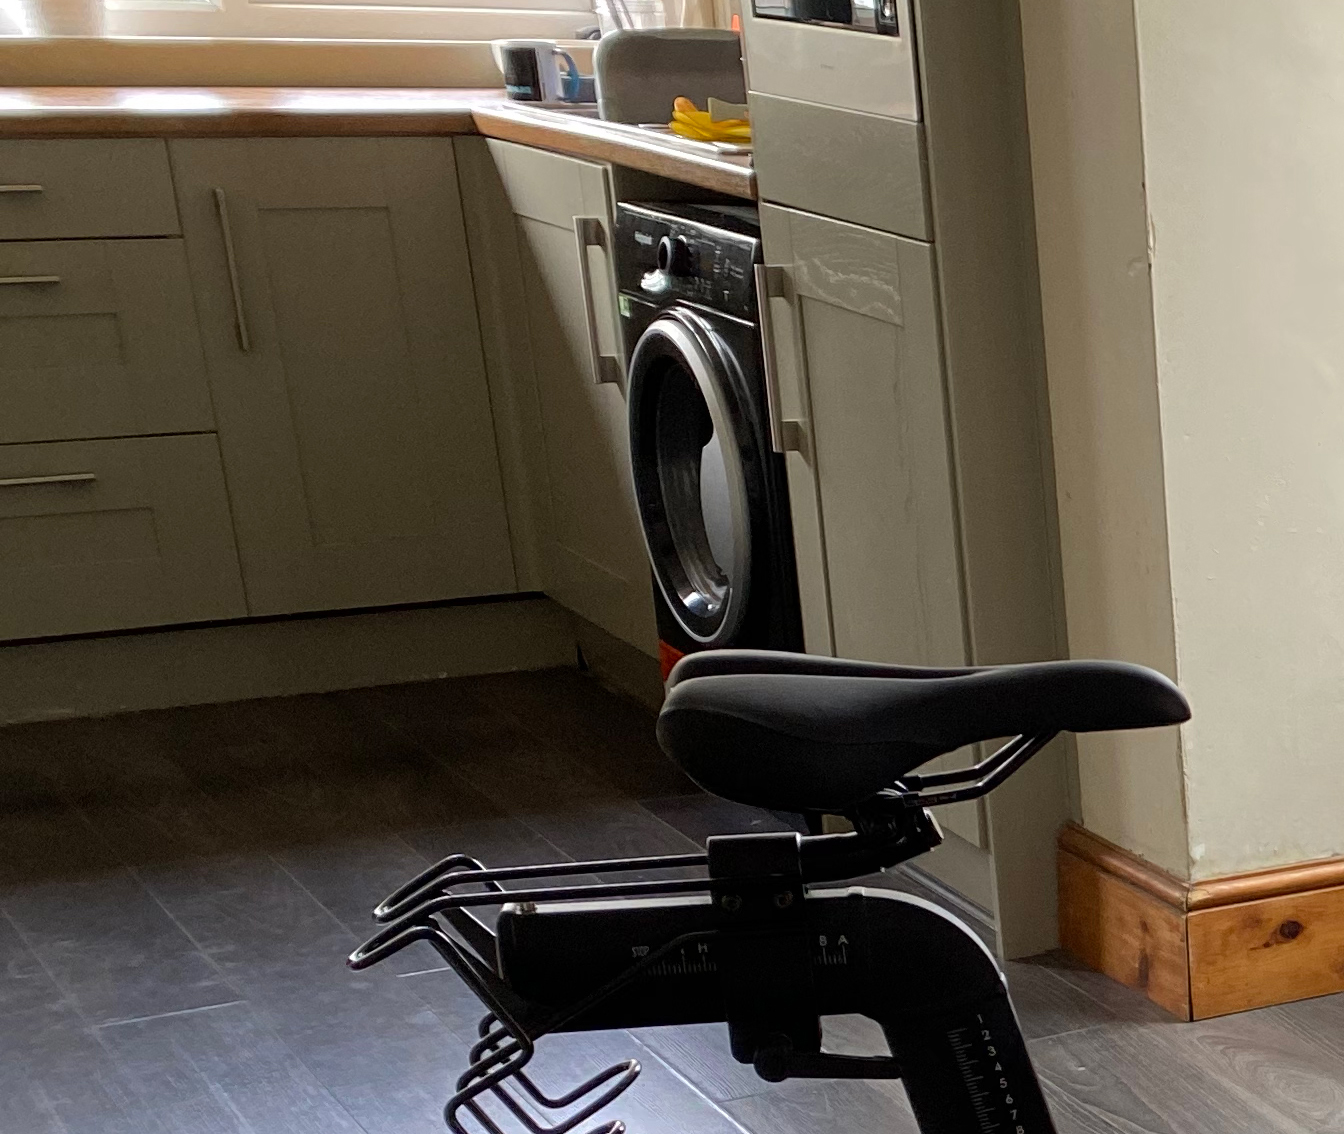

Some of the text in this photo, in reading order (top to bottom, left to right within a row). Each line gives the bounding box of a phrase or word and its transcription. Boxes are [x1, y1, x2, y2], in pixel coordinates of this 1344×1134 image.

[818, 934, 828, 946] B
[837, 934, 849, 945] A
[977, 1013, 983, 1024] 1
[981, 1030, 991, 1040] 2
[987, 1046, 996, 1056] 3
[994, 1062, 1002, 1071] 4
[1000, 1078, 1008, 1088] 5
[1005, 1094, 1013, 1104] 6
[1010, 1109, 1017, 1120] 7
